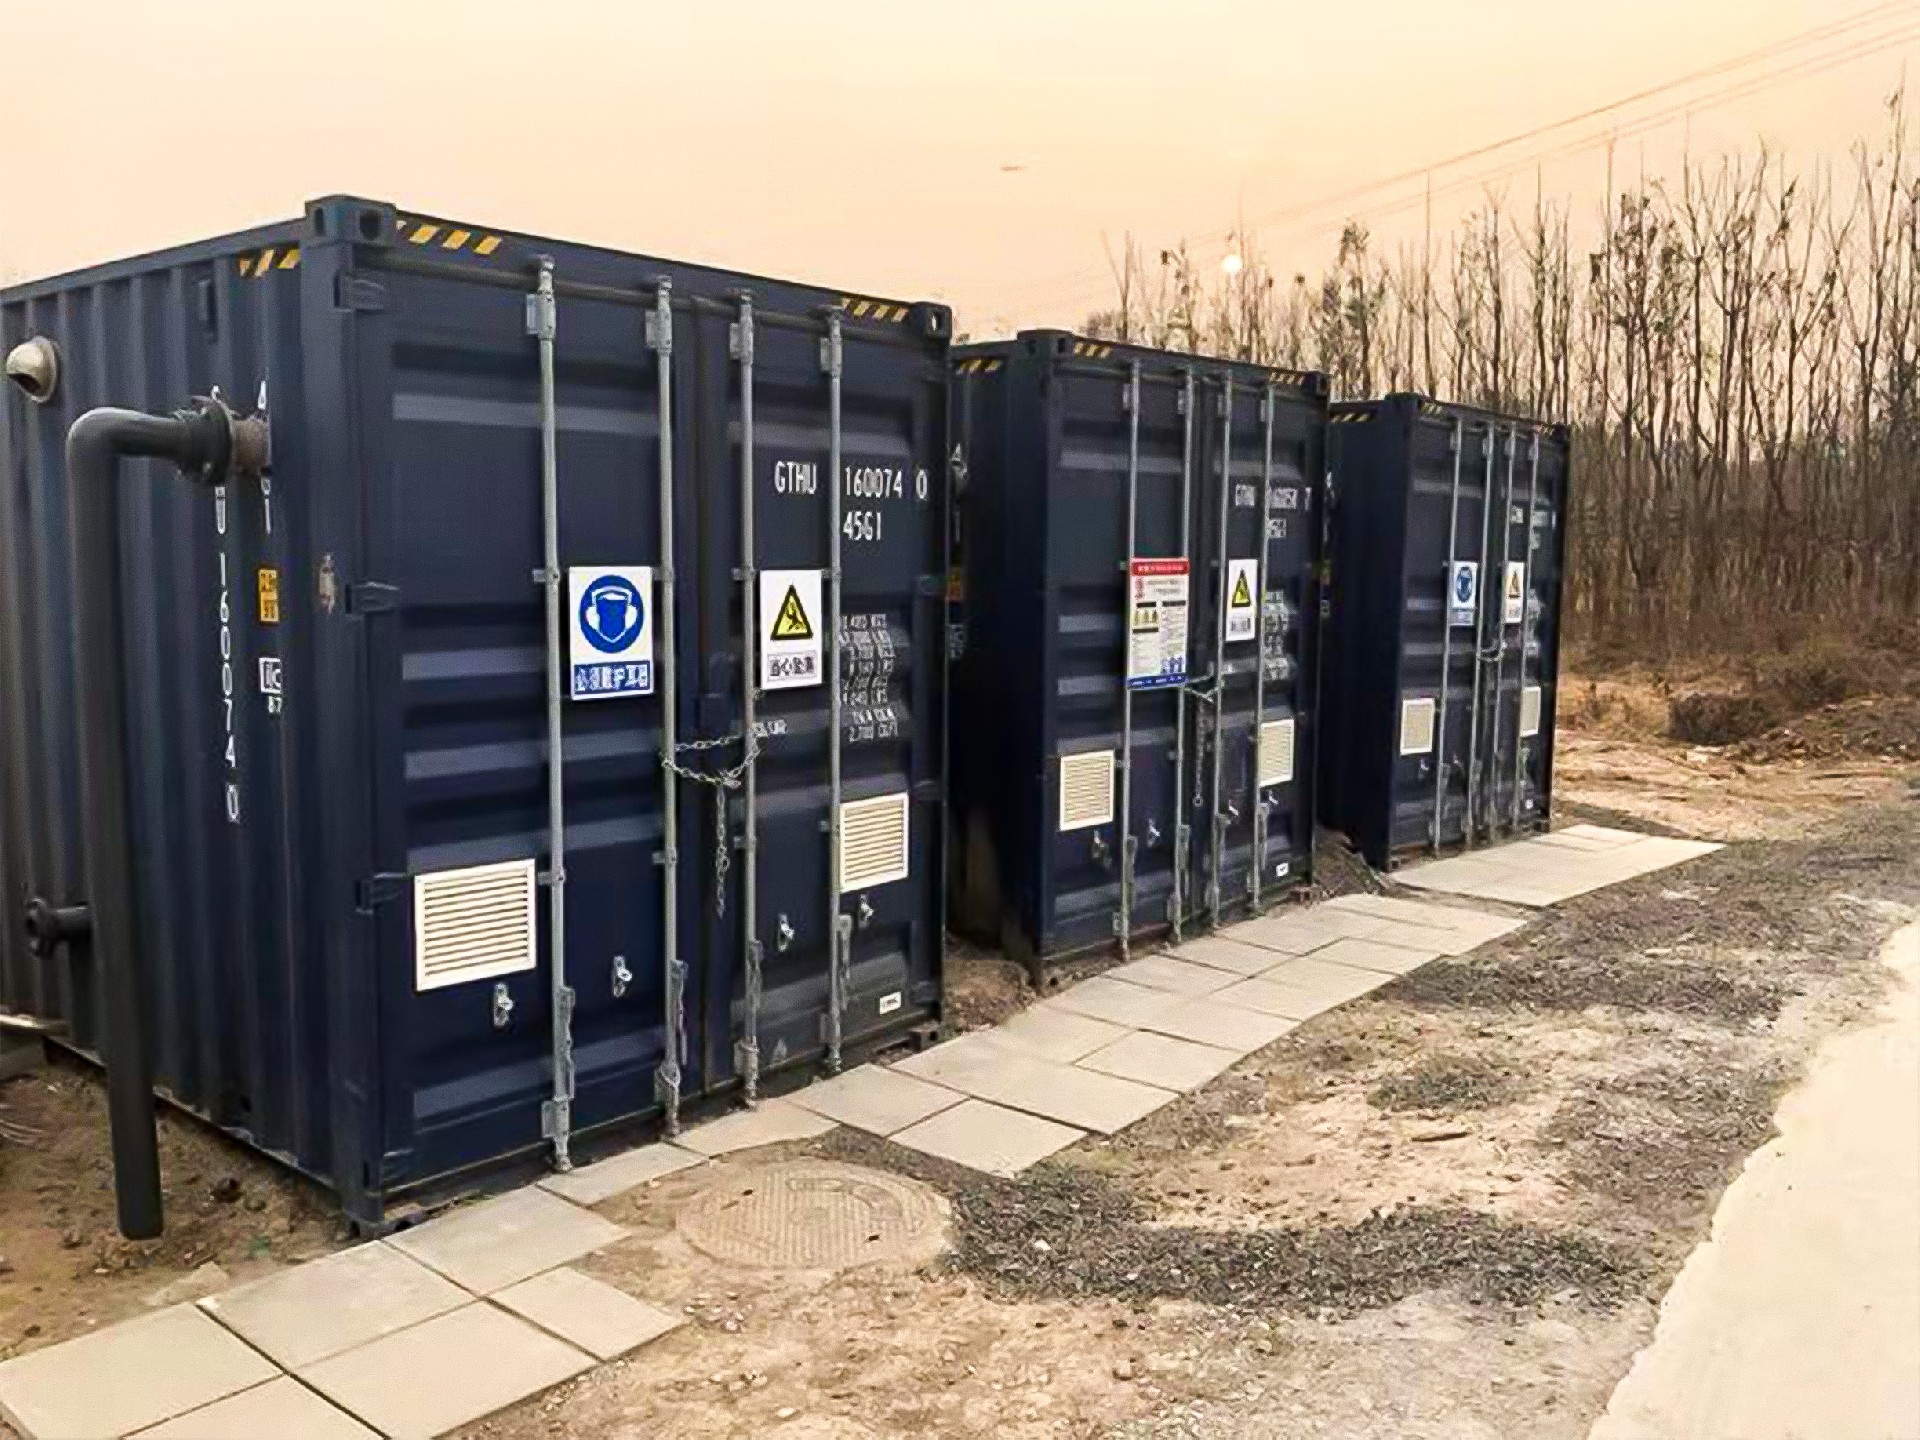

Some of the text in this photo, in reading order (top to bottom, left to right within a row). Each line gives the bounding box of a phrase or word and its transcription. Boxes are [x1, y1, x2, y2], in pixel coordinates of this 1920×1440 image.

[774, 460, 928, 499] GTHU 160074 0
[842, 511, 881, 541] 45G1
